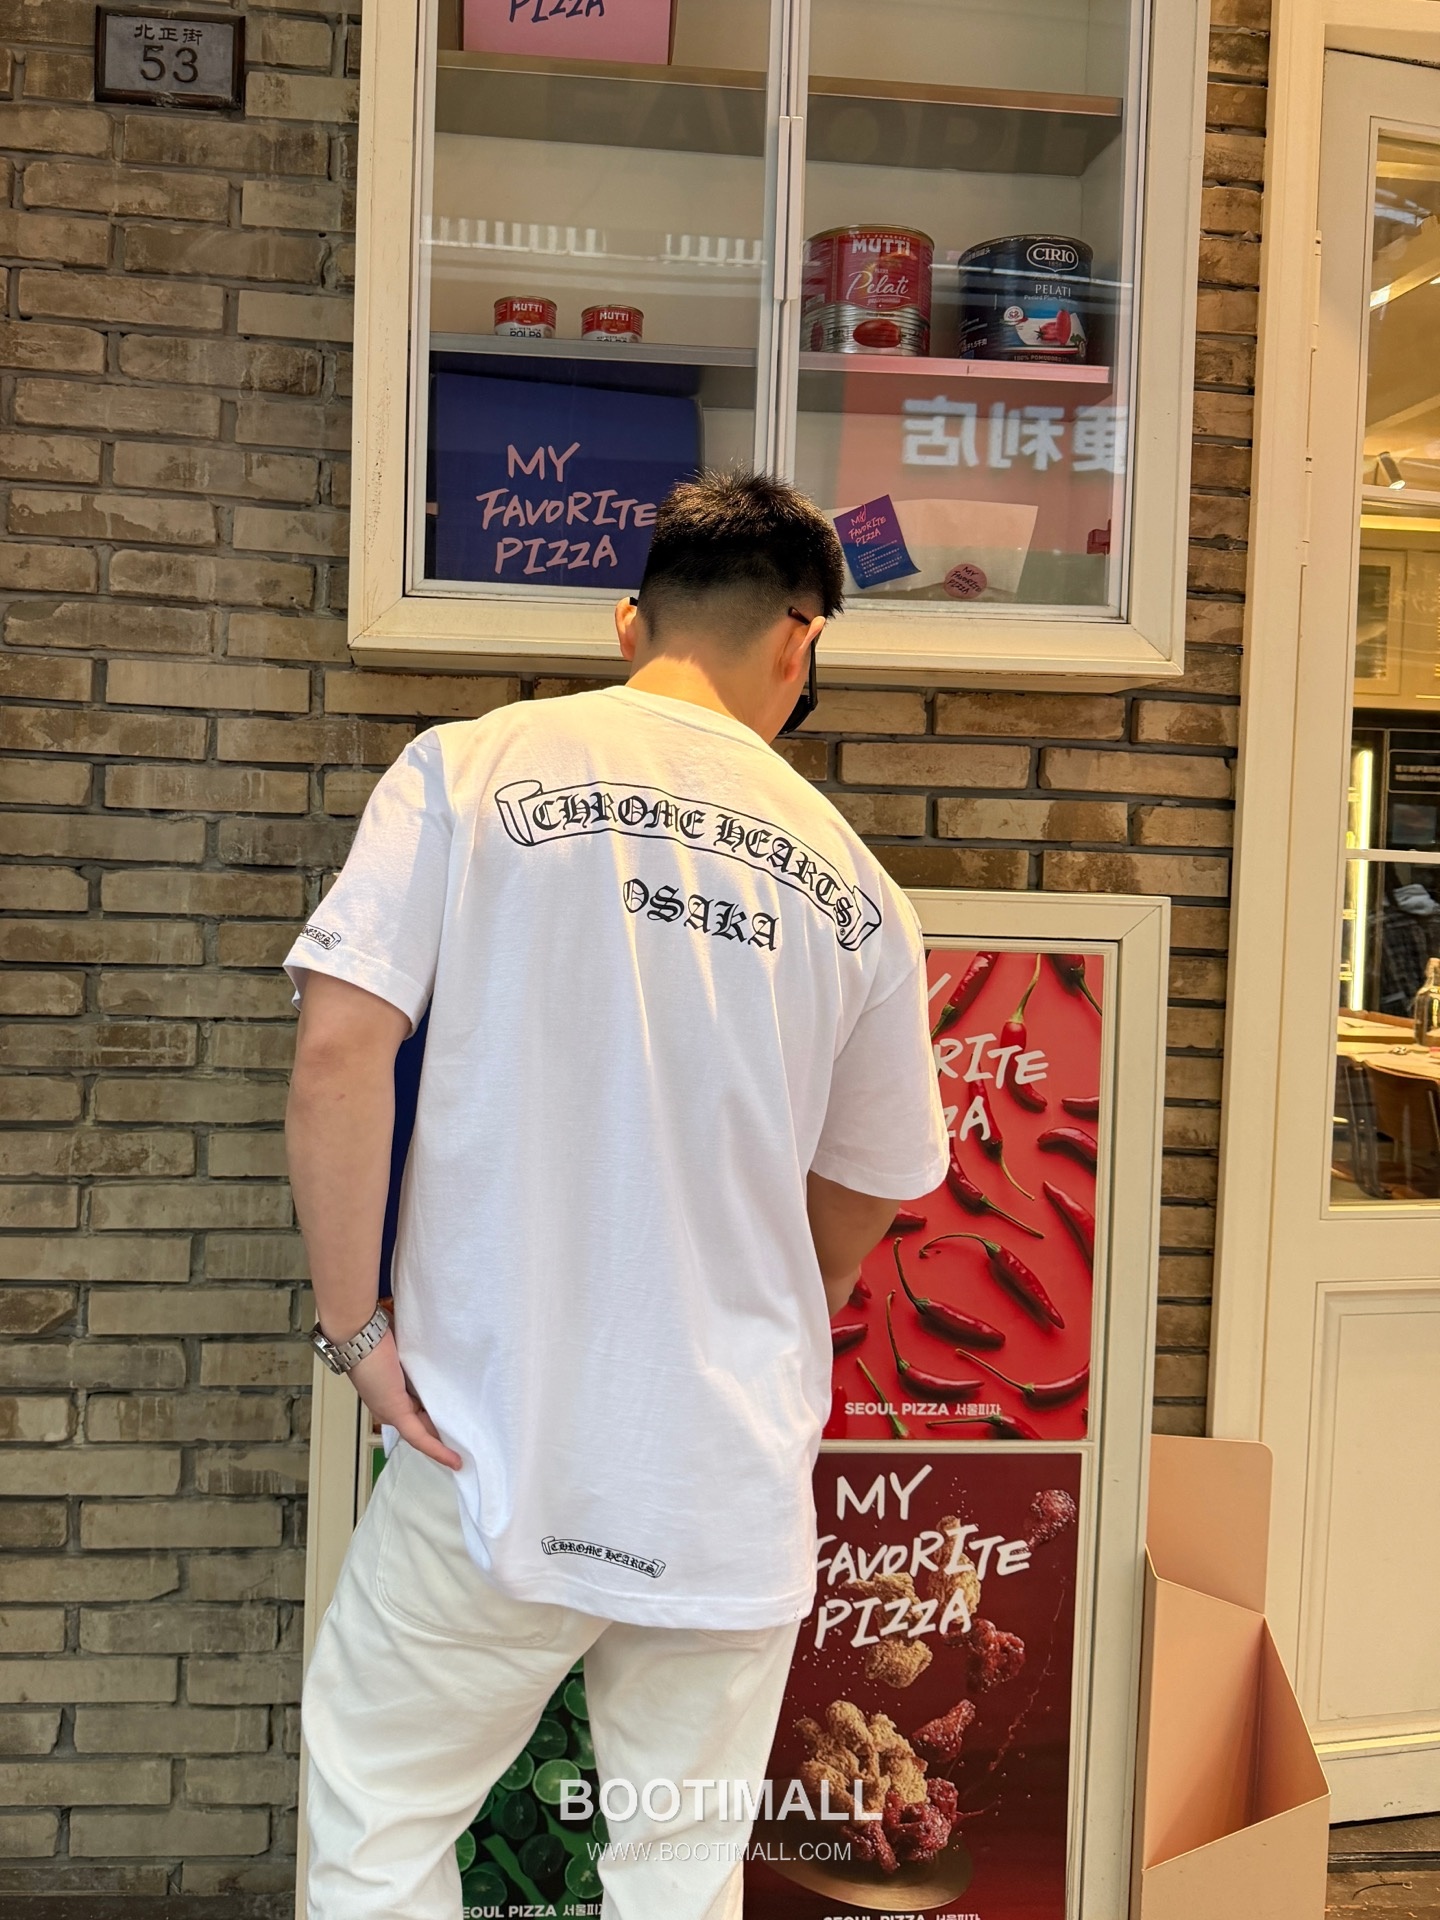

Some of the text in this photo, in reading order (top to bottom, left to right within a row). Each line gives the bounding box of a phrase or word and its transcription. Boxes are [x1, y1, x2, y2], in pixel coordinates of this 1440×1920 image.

[133, 23, 203, 46] 北正街
[140, 44, 199, 83] 53
[852, 238, 911, 257] MUTTI
[1032, 247, 1075, 264] CIRIO
[845, 270, 909, 300] Pelati
[1034, 284, 1071, 297] PELATI
[512, 303, 543, 313] MUTTI
[599, 311, 629, 322] MUTTI
[507, 442, 581, 483] MY
[475, 487, 658, 531] FAVORITE
[848, 516, 887, 540] FAVORITE
[855, 527, 881, 548] PIZZA
[494, 534, 619, 575] PIZZA
[962, 566, 979, 577] MY
[531, 791, 854, 928] CHROME HEARTS
[622, 877, 780, 952] OSAKA
[932, 1032, 1050, 1090] RITE
[844, 1402, 1002, 1416] SEOUL PIZZA 서울피자
[836, 1463, 934, 1521] MY
[550, 1540, 656, 1575] CHROME HEARTS
[814, 1587, 973, 1650] PIZZA
[463, 1906, 505, 1919] EOUL
[508, 1904, 558, 1918] PIZZA
